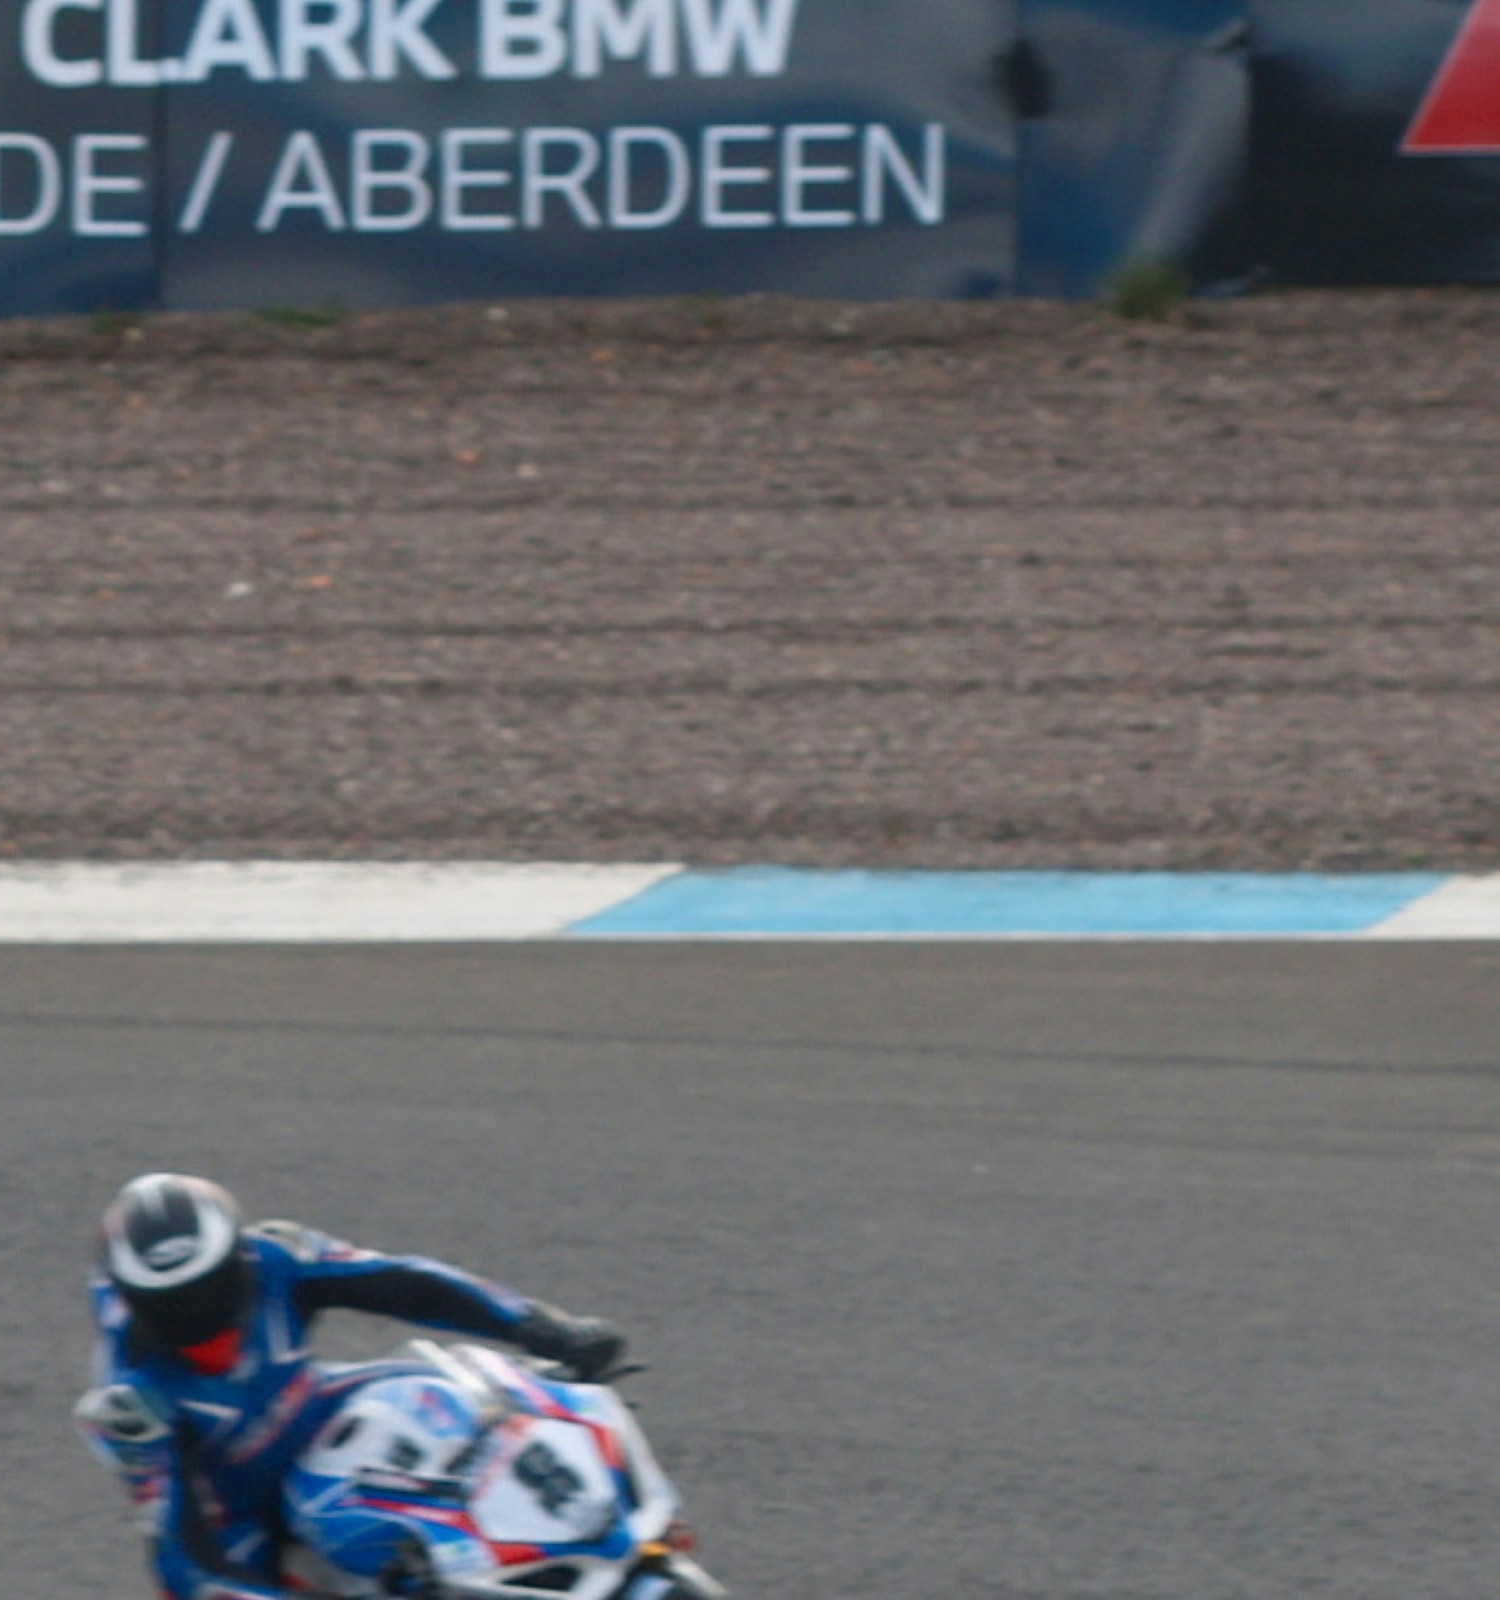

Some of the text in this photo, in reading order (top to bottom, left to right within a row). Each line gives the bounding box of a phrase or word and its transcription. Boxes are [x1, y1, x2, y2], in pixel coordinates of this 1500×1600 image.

[19, 0, 457, 86] CLARK
[476, 0, 791, 79] BMW
[177, 131, 233, 233] /
[255, 123, 945, 232] ABERDEEN
